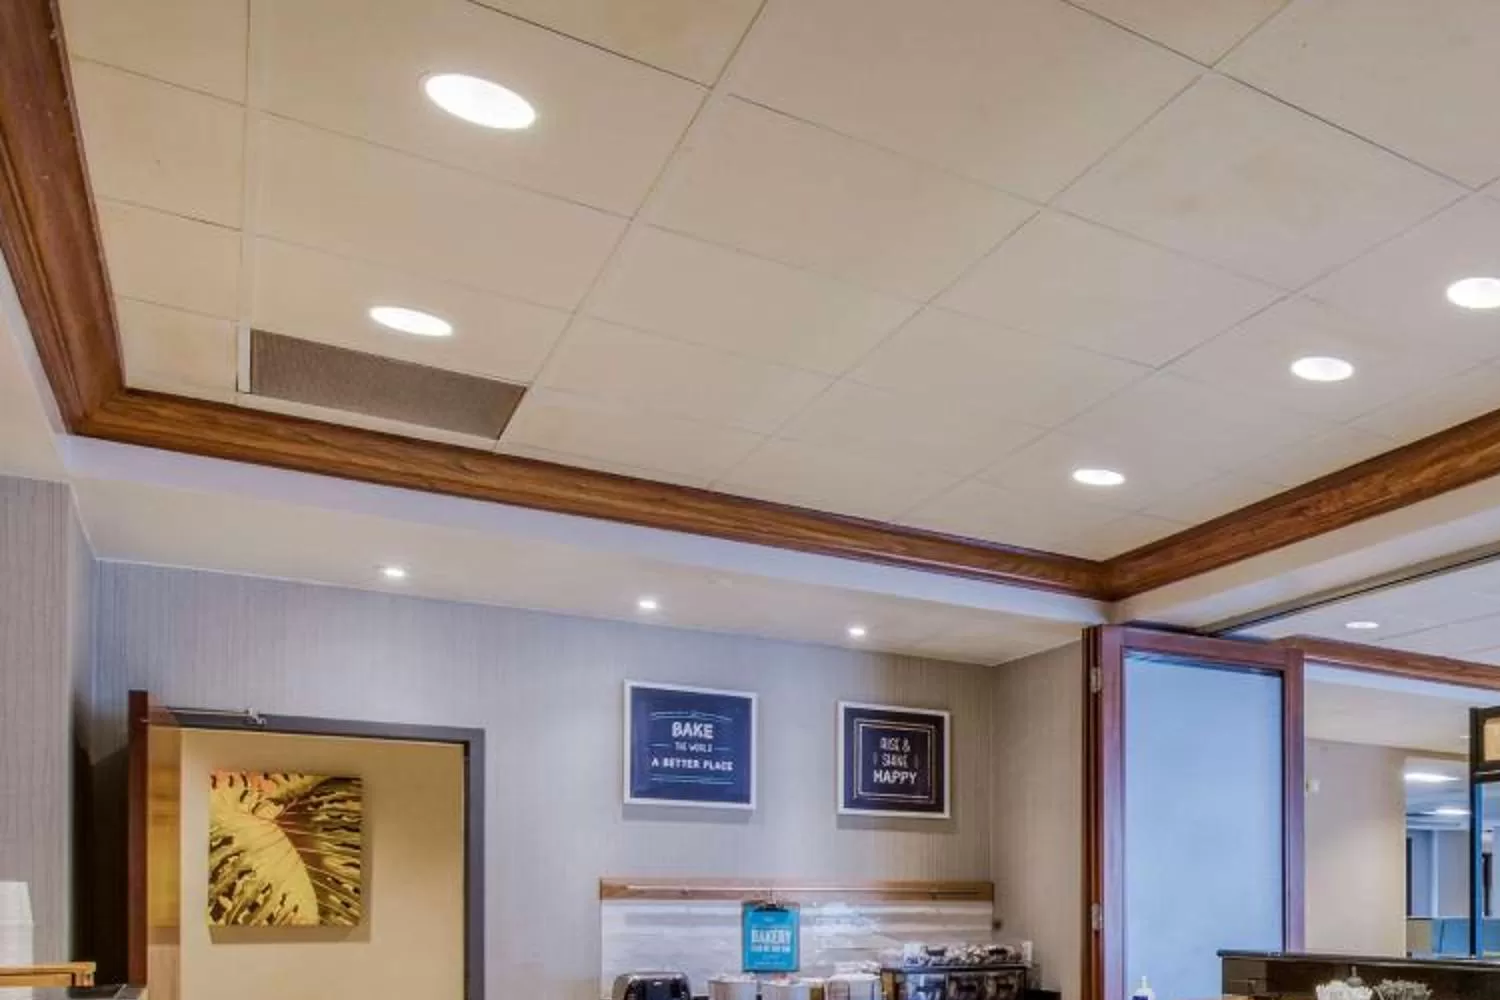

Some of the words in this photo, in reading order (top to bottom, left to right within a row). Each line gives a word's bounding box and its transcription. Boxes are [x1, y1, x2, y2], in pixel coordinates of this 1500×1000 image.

[671, 721, 714, 739] BAKE
[675, 741, 687, 751] THE
[651, 757, 660, 767] A
[663, 757, 700, 769] BETTER
[703, 759, 733, 772] PLACE
[873, 769, 917, 784] HAPPY
[751, 929, 792, 944] BAKERY
